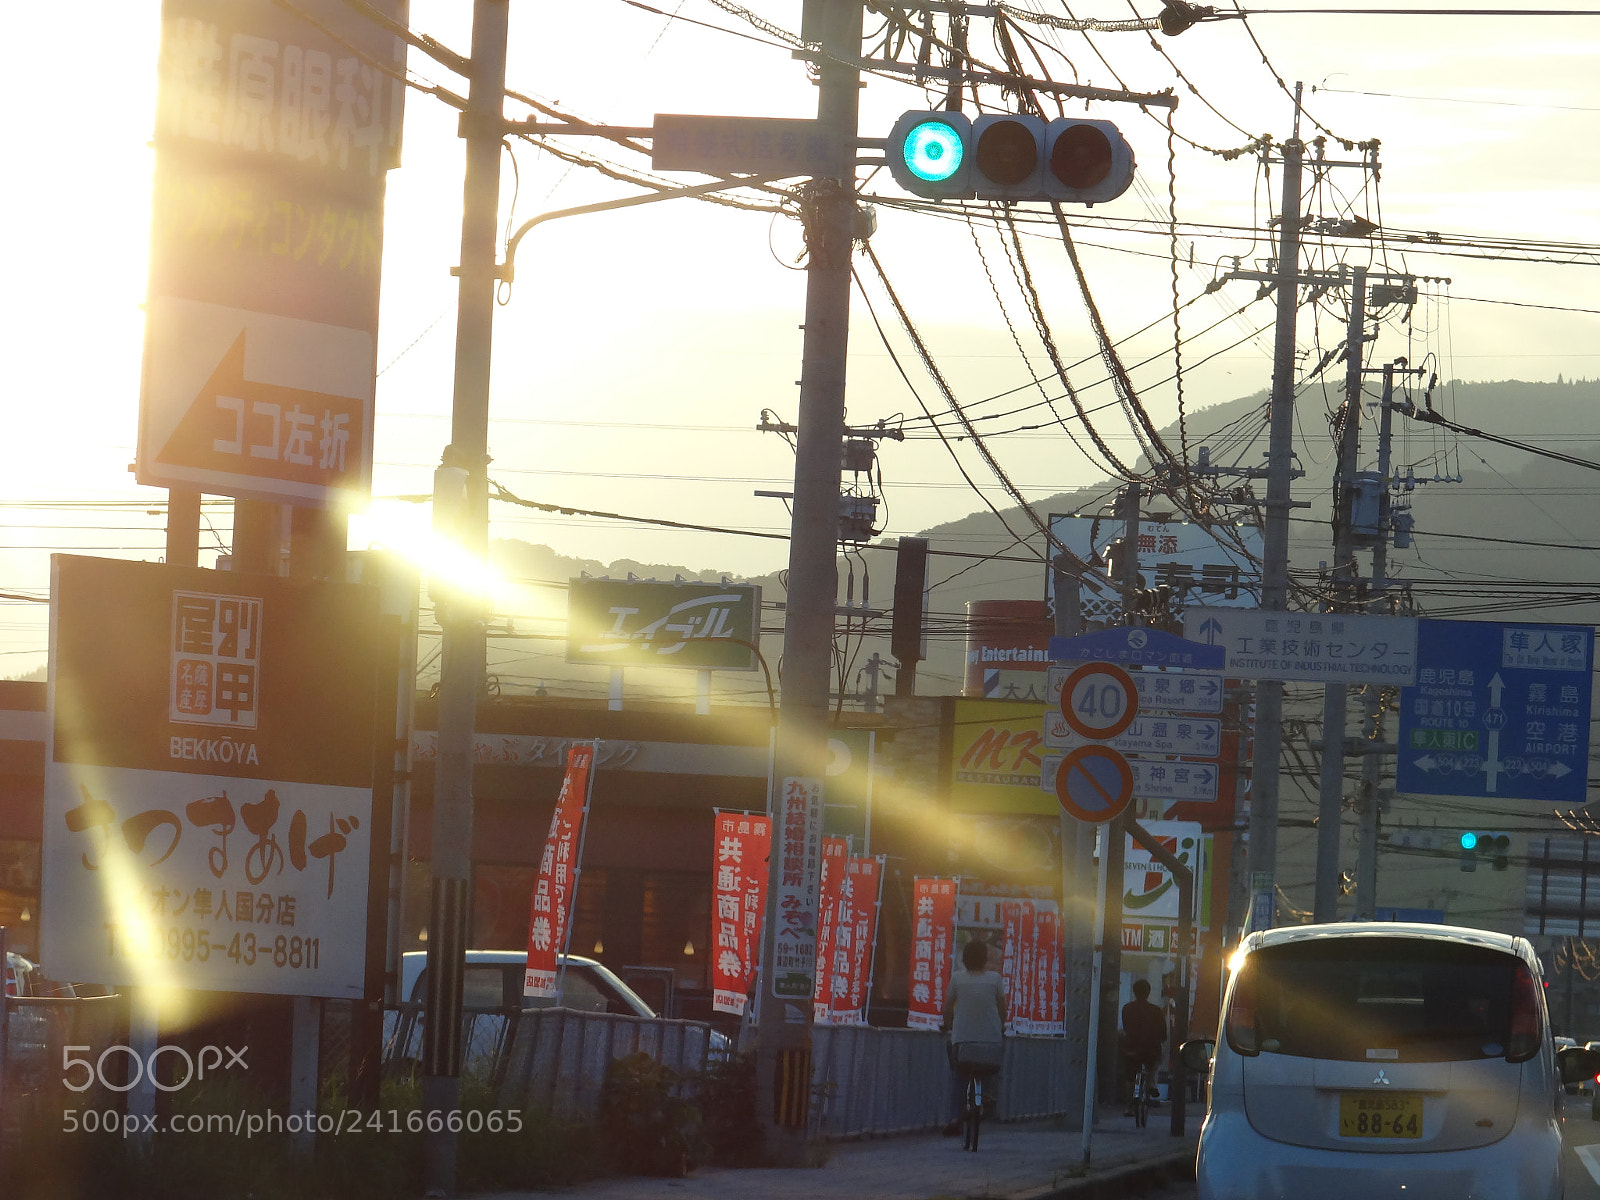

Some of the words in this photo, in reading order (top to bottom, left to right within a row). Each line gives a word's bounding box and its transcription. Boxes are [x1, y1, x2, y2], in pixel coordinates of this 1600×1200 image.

[213, 396, 351, 473] ココ左折
[1236, 637, 1411, 660] 工業技術センター
[1509, 631, 1582, 654] 隼人塚
[981, 645, 1050, 663] Entertain
[1230, 658, 1280, 670] INSTITUTE
[1281, 659, 1294, 671] OF
[1295, 661, 1349, 673] INDUSTRIAL
[1350, 663, 1413, 676] TECHNOLOGY
[1419, 668, 1474, 686] 鹿児島
[1078, 684, 1121, 718] 40
[1420, 686, 1473, 697] Kagoshima
[1528, 683, 1579, 704] 霧島
[1415, 699, 1476, 718] 国道10号
[1527, 705, 1579, 718] Kirishima
[1420, 718, 1454, 728] ROUTE
[1457, 719, 1469, 728] 10
[1526, 721, 1577, 742] 空港
[1155, 740, 1173, 750] Spa
[1525, 743, 1577, 755] AIRPORT
[1148, 929, 1165, 948] 酒
[1357, 1111, 1418, 1135] 88-64
